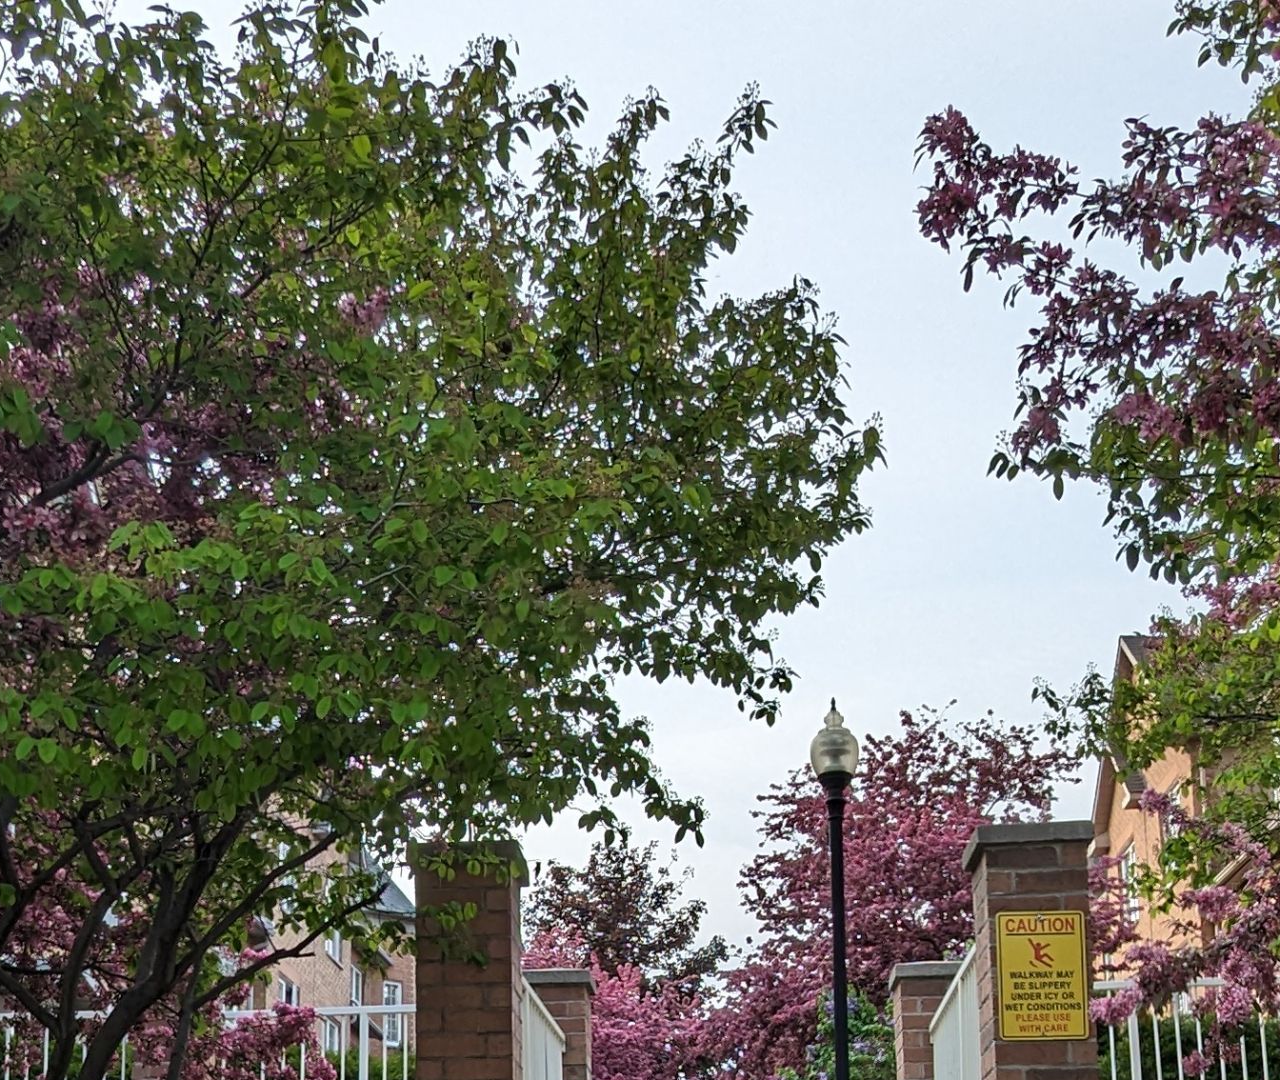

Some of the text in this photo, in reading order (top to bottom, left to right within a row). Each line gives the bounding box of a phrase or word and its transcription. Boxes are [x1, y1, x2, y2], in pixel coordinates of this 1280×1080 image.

[1005, 917, 1075, 932] CAUTION
[1009, 970, 1075, 979] WALKWAY MAY
[1013, 981, 1071, 990] BE SLIPPERY
[1010, 991, 1075, 1001] UNDER ICY OR
[1005, 1002, 1082, 1011] WET CONDITIONS
[1016, 1013, 1071, 1022] PLEASE USE
[1019, 1024, 1069, 1032] WITH CARE
